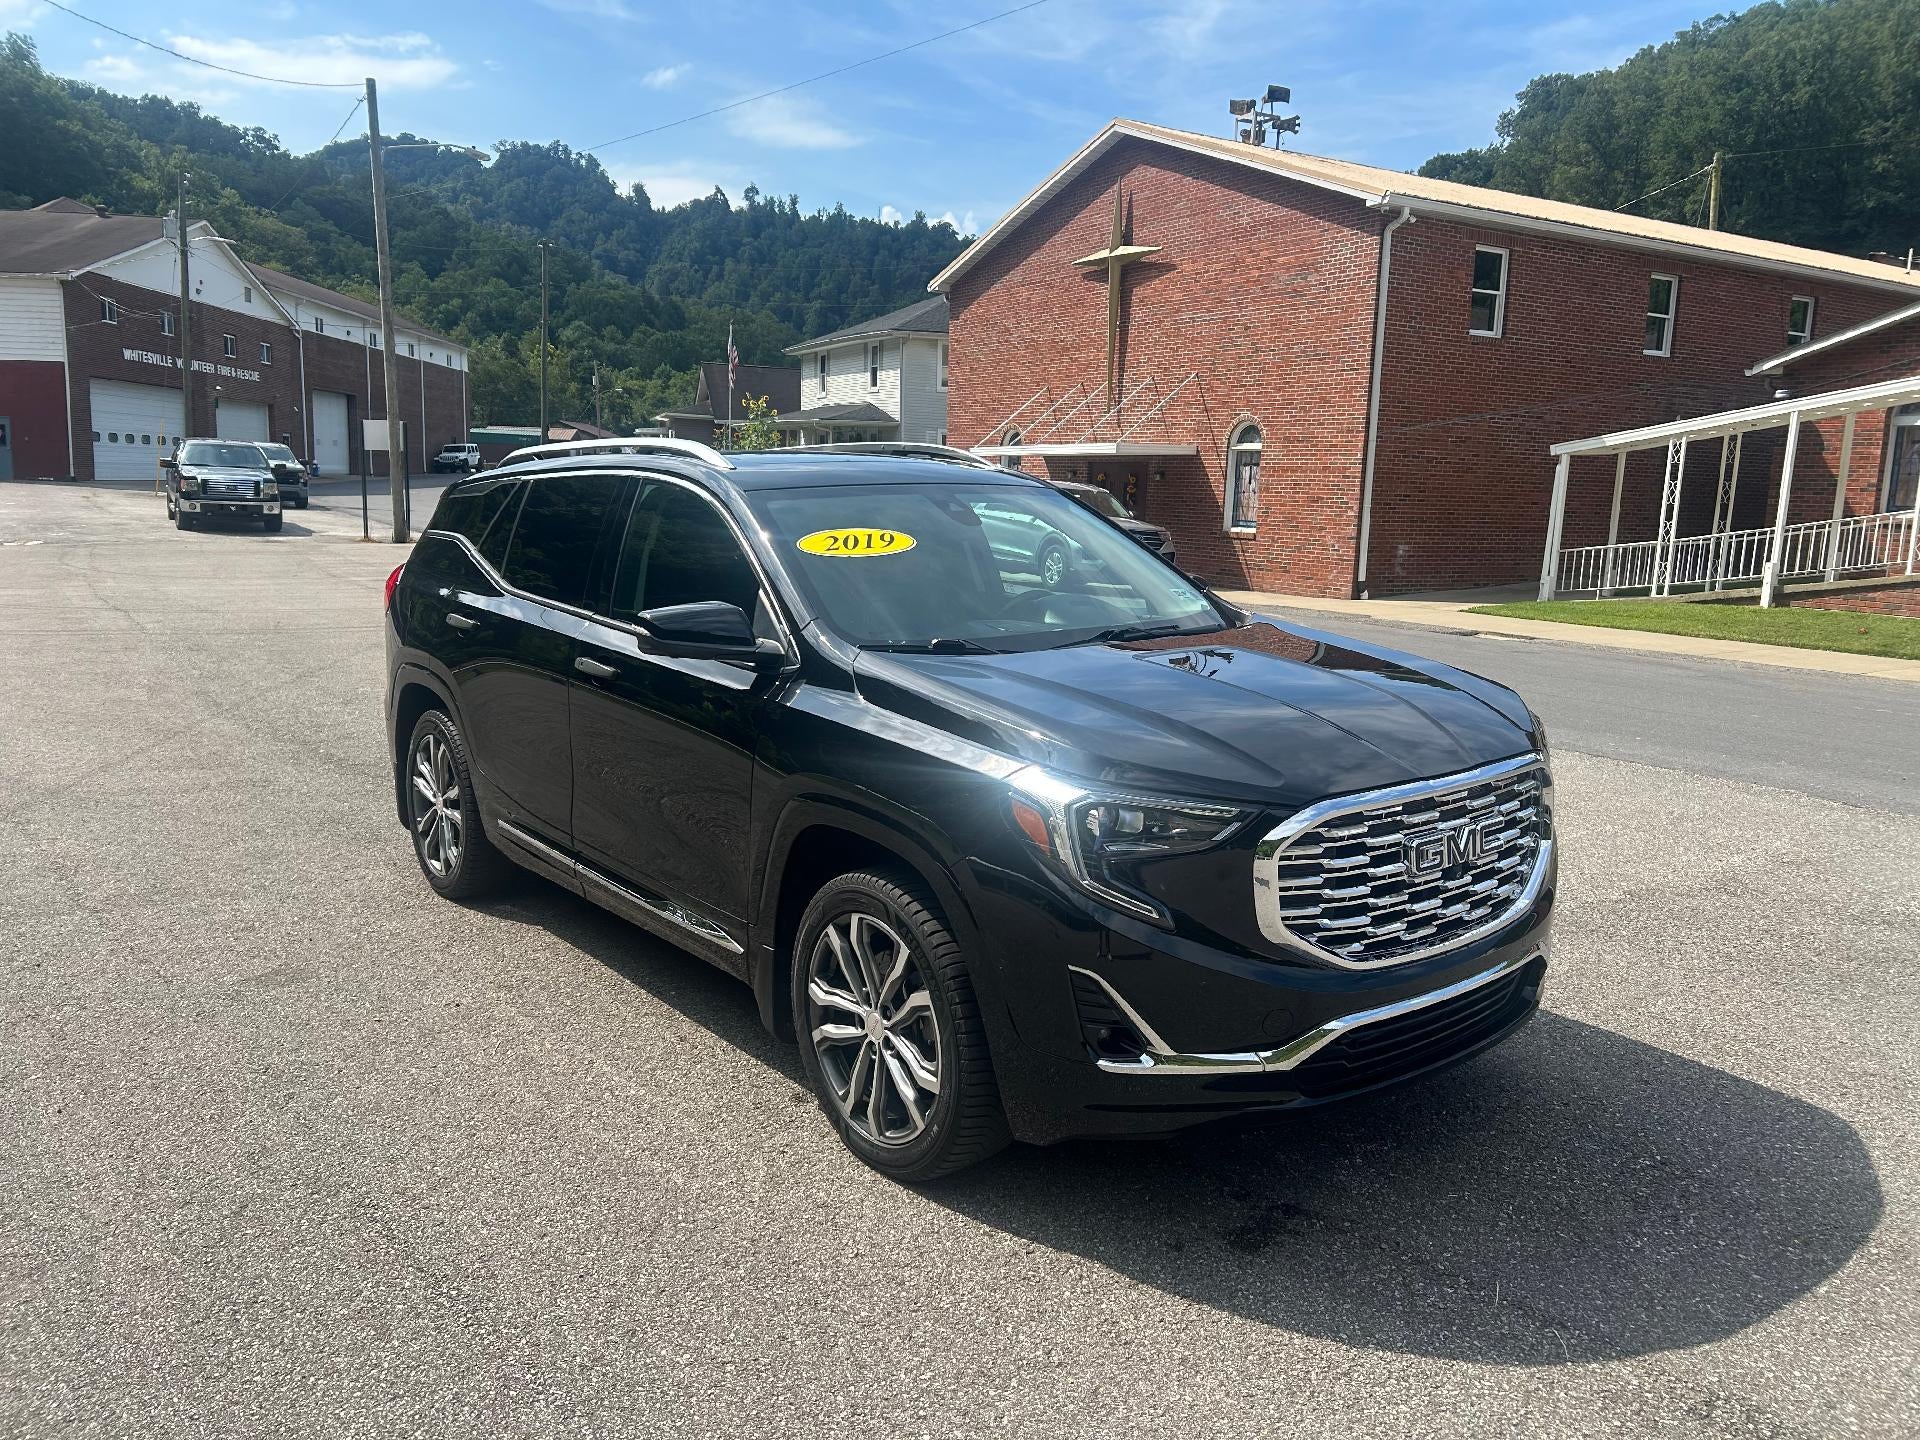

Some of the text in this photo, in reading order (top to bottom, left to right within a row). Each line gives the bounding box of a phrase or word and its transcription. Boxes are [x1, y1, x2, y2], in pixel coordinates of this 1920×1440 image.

[122, 347, 173, 367] WHITESVILLE
[175, 356, 215, 374] VOUNTEER
[217, 364, 231, 377] FIRE
[236, 368, 260, 382] RESCUE
[824, 532, 895, 552] 2019
[1402, 815, 1505, 877] GMC
